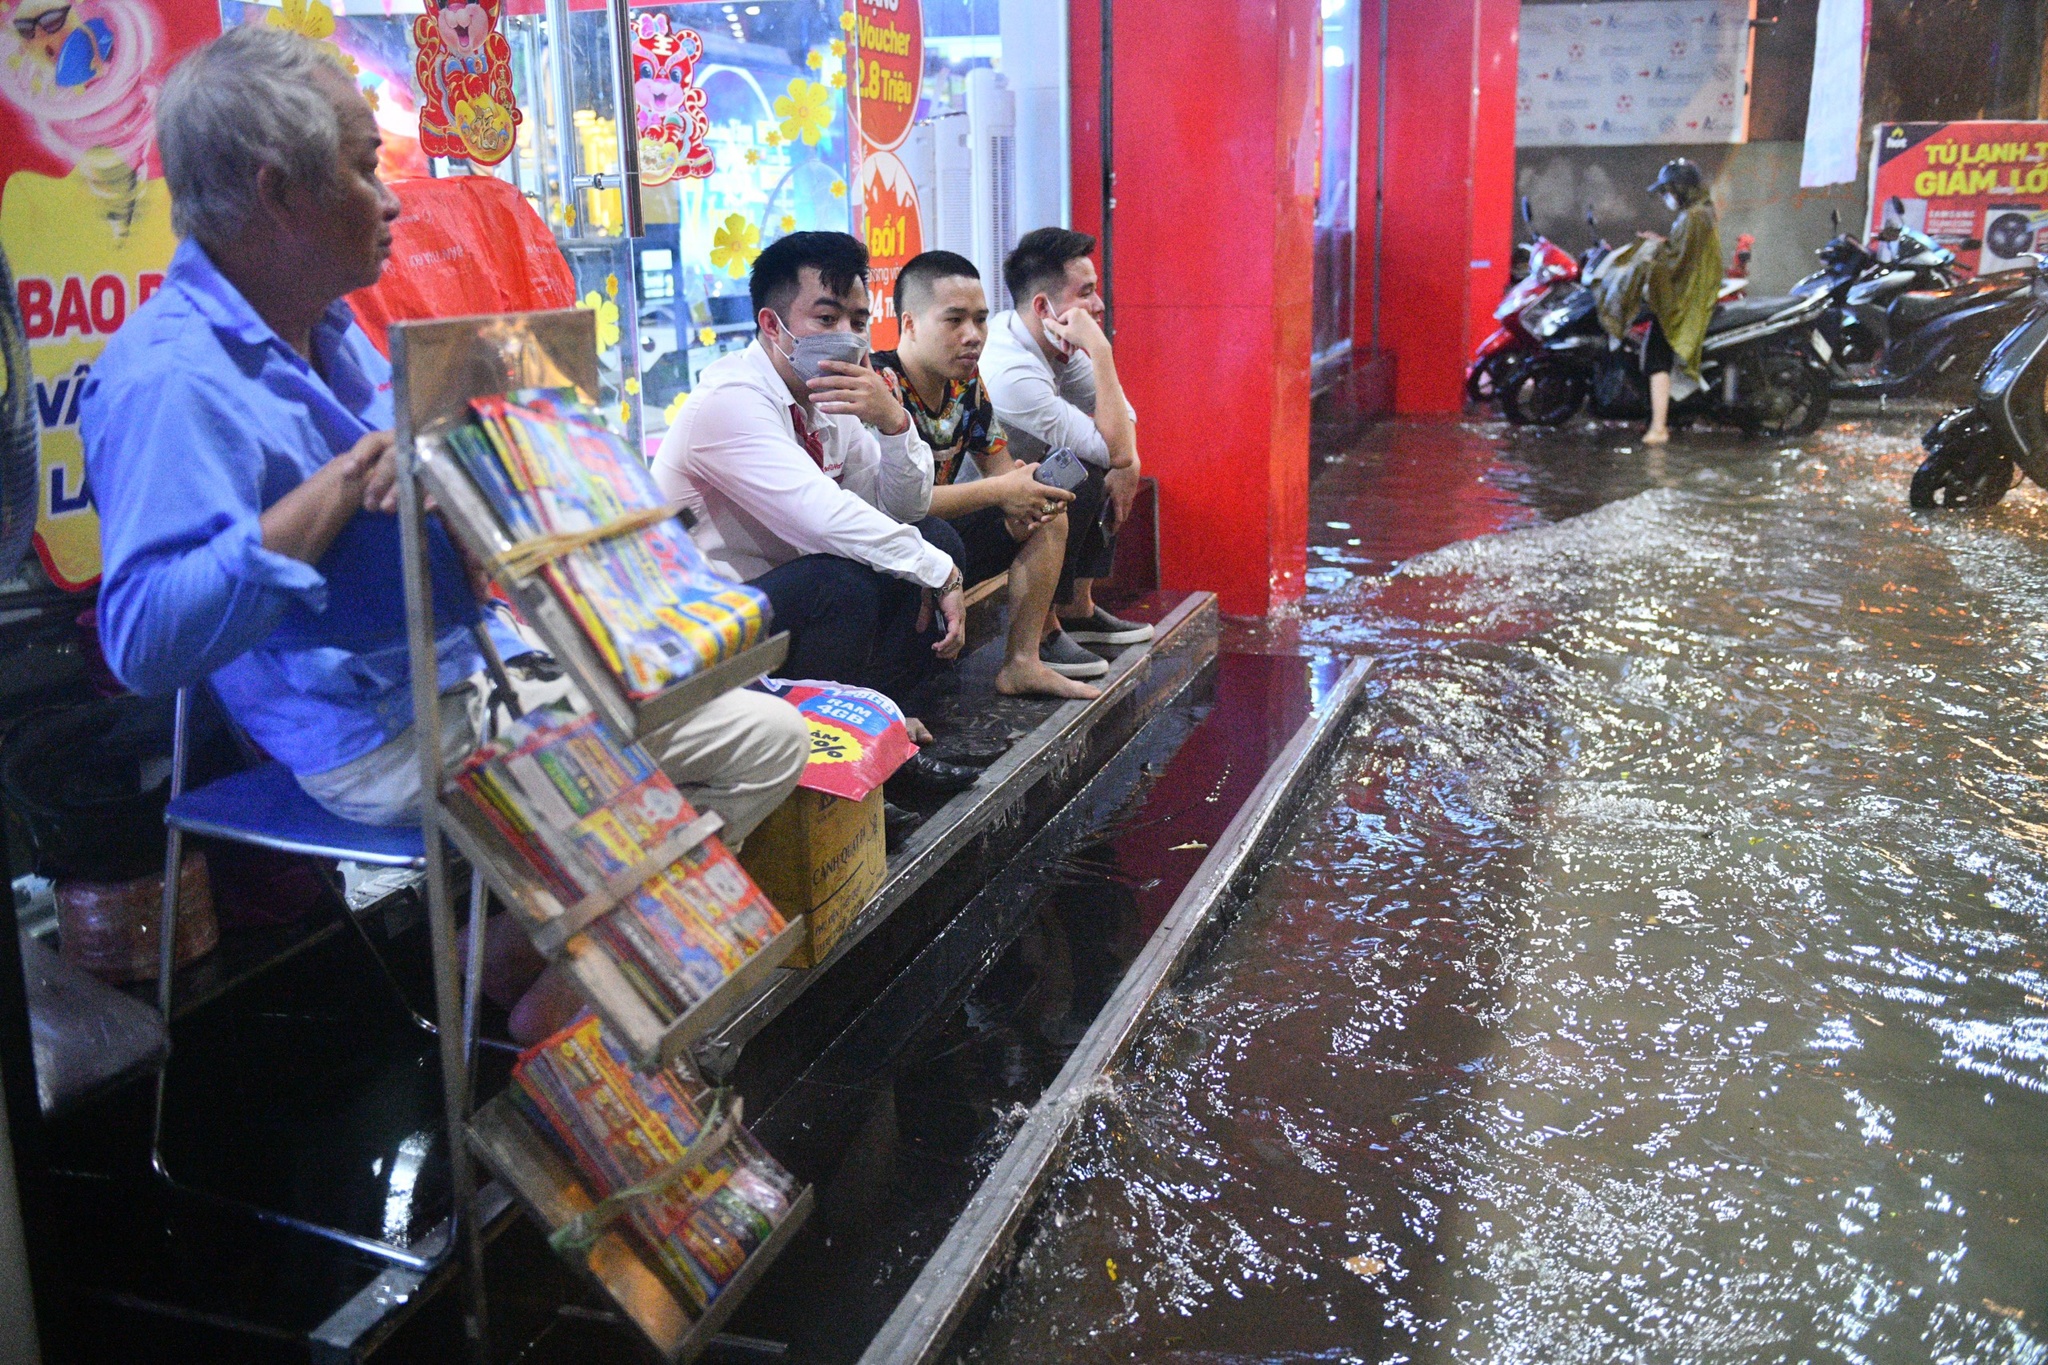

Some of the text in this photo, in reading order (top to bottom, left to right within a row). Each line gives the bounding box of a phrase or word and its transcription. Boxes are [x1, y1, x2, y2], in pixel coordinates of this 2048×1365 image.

[880, 68, 913, 112] Triệu
[1925, 138, 1958, 165] TỦ
[1961, 142, 2029, 169] LẠNH
[1914, 161, 1999, 197] GIẢM
[871, 213, 896, 257] ĐỔI
[896, 215, 906, 256] 1
[17, 273, 126, 340] BAO
[816, 704, 866, 725] 4GB
[826, 698, 873, 718] RAM
[810, 738, 848, 759] 0%
